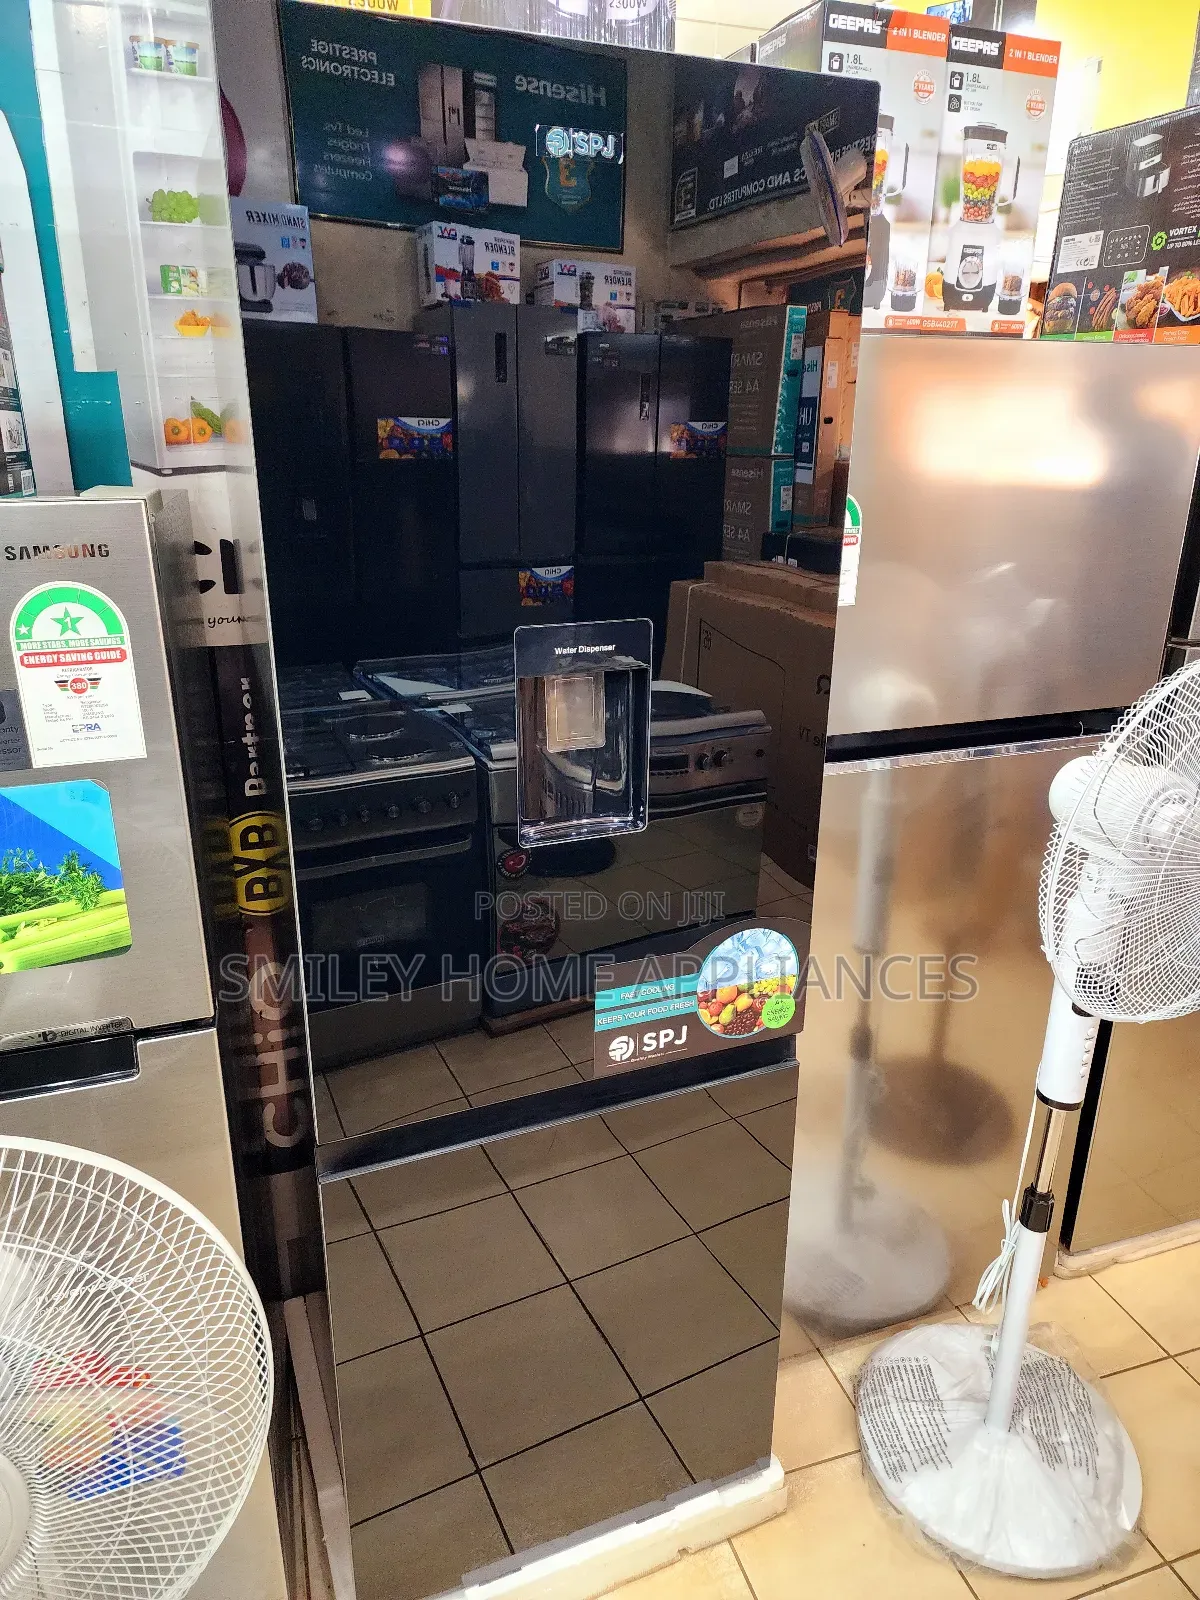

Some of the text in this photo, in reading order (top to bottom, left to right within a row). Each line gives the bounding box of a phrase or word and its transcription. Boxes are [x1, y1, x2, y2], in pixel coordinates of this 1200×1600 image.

[829, 14, 883, 35] GEEPAS
[913, 31, 947, 43] BLENDER
[951, 36, 1000, 56] GEEPAS
[846, 53, 863, 66] 1.8L
[1014, 50, 1022, 59] IN
[1027, 52, 1058, 64] BLENDER
[966, 72, 982, 84] 1.8L
[574, 130, 615, 159] SPJ
[1169, 225, 1198, 237] VORTEX
[5, 543, 110, 561] SAMSUNG
[20, 641, 42, 651] MORE
[69, 638, 90, 648] MORE
[90, 637, 121, 647] SAVINGS
[554, 644, 616, 655] Water Dispenser
[24, 650, 122, 665] ENERGY SAVING GUIDE
[71, 682, 87, 690] 380
[597, 999, 695, 1026] KEEPS YOUR FOOD FRESH
[61, 1027, 89, 1037] DIGITAL
[642, 1025, 688, 1052] SPJ
